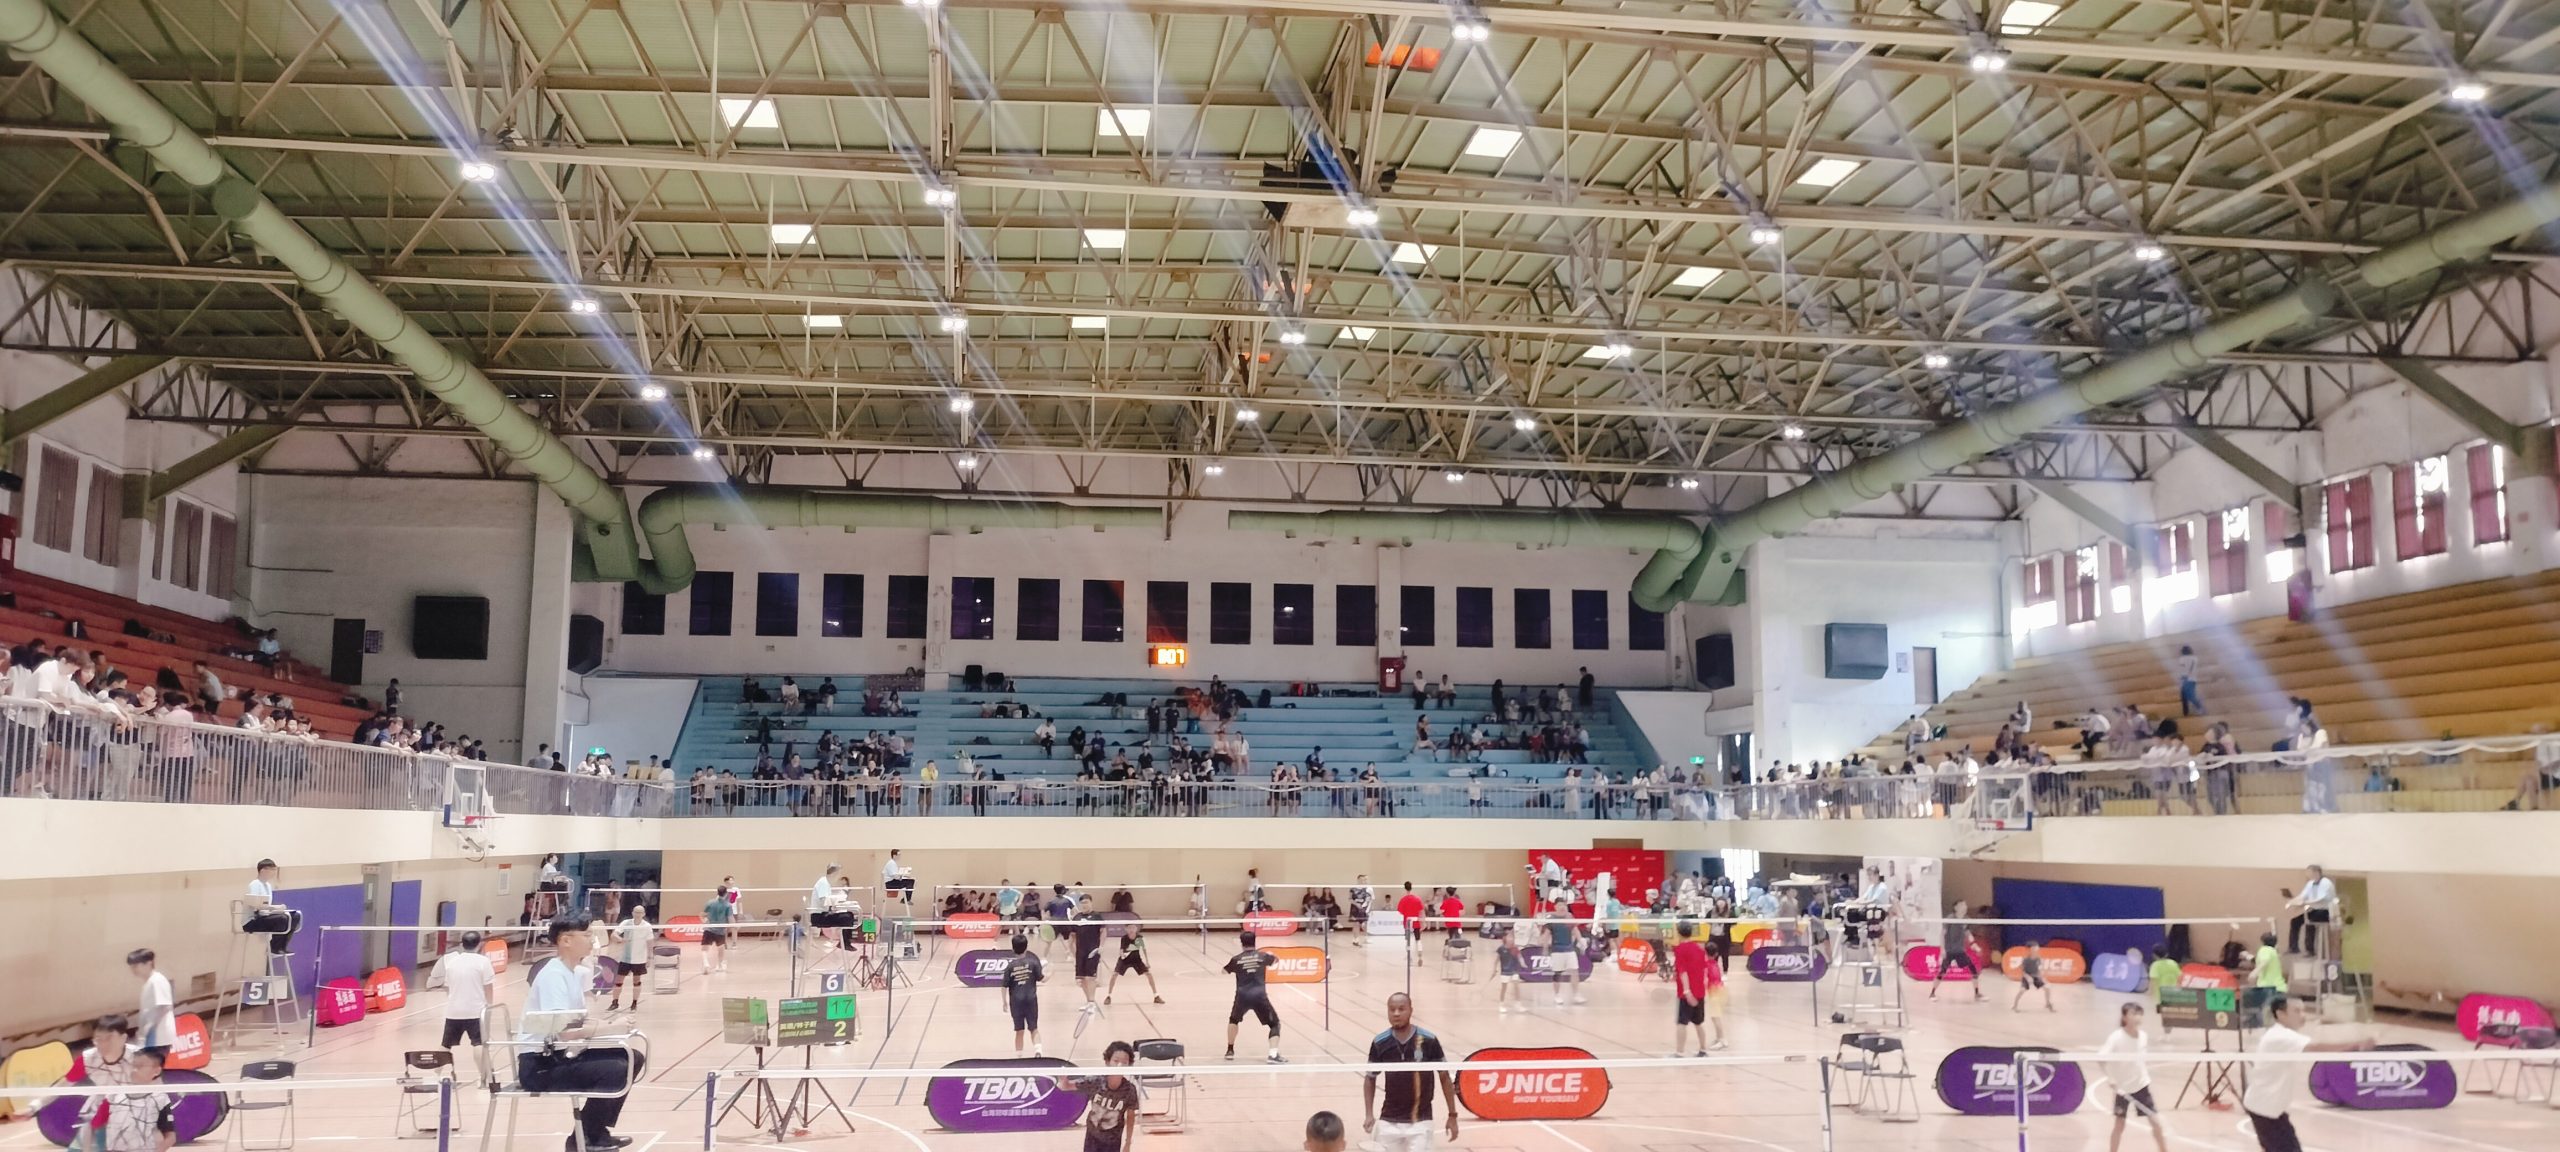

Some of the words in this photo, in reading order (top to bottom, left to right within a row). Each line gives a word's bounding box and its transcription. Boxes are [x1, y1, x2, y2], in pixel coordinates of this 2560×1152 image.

[826, 974, 838, 990] 6
[1869, 969, 1877, 984] 7
[249, 982, 263, 999] 5
[831, 999, 852, 1016] 17
[2212, 992, 2231, 1007] 12
[833, 1021, 847, 1037] 2
[964, 1077, 1041, 1100] TBDA
[1093, 1093, 1124, 1111] FILA
